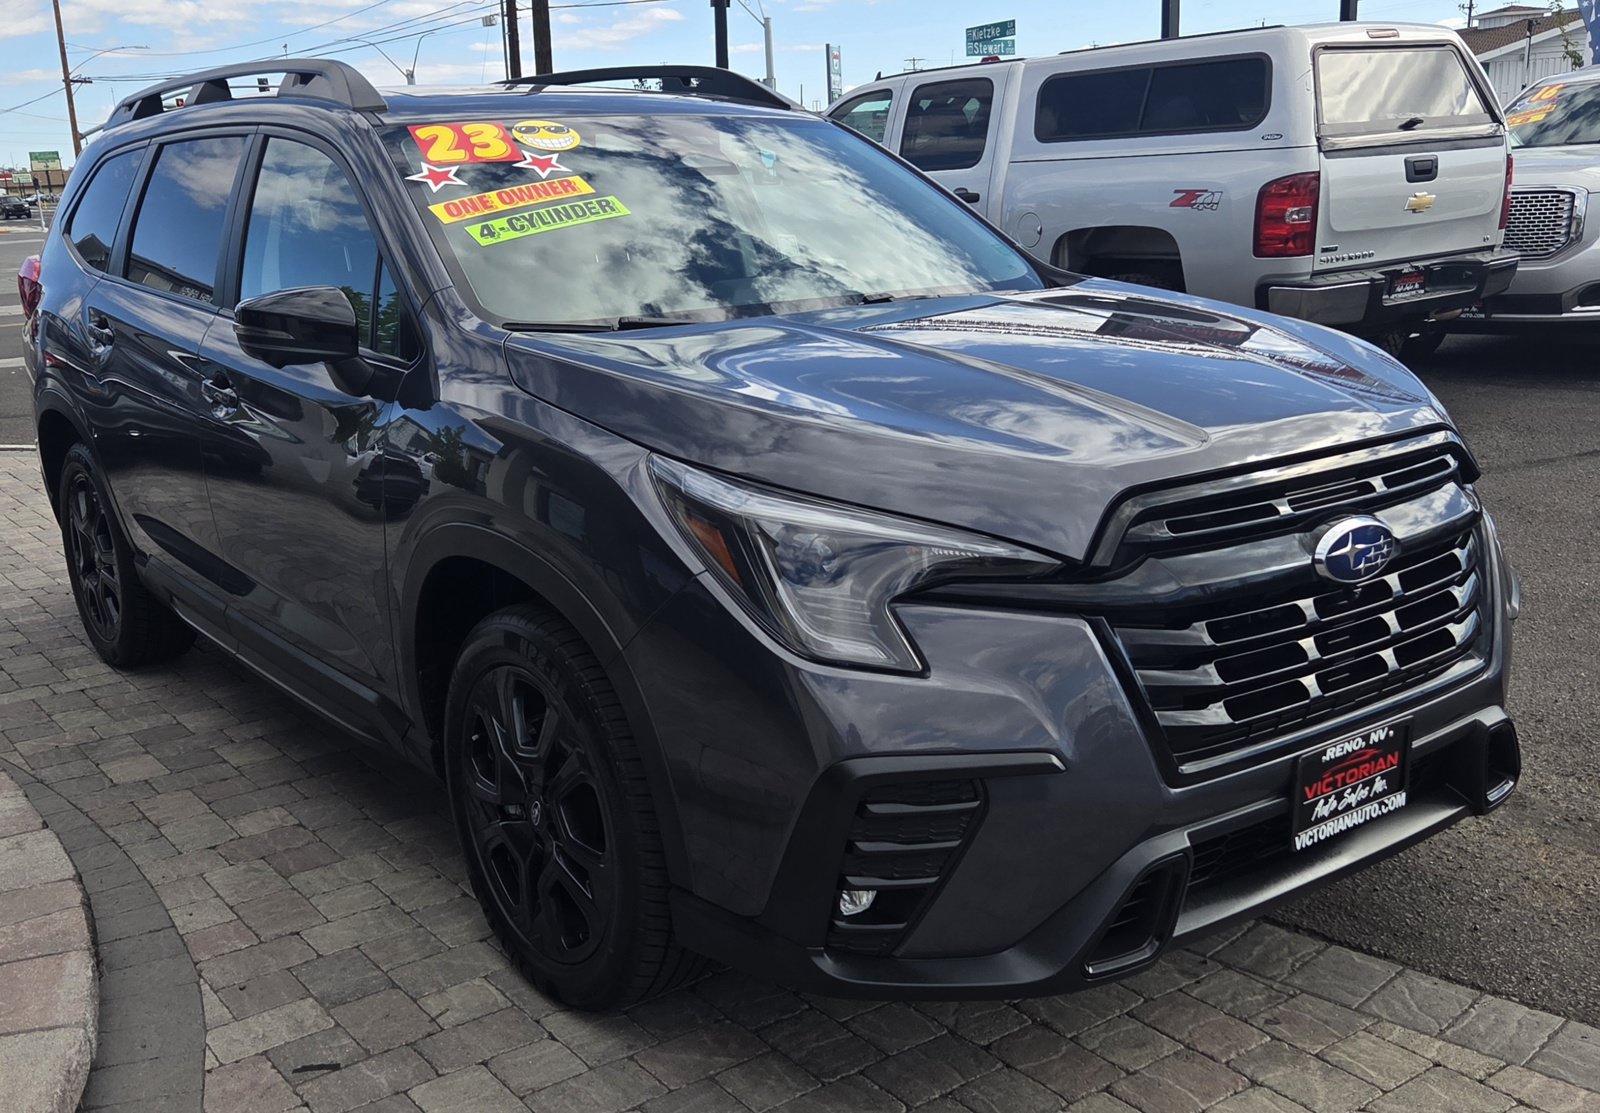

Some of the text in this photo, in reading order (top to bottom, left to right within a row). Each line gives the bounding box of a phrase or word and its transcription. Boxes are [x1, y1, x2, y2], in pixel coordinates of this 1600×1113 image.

[972, 26, 1000, 40] Kietzke
[973, 42, 1004, 54] Stewart
[415, 123, 509, 162] 23
[444, 179, 580, 219] ONE OWNER
[479, 198, 619, 241] 4-CYLINDER
[1319, 250, 1375, 265] SILVERADO
[1325, 737, 1366, 761] RENO,
[1304, 752, 1399, 799] VICTORIAN
[1295, 792, 1407, 851] VICTORIANAUTO.COM
[1312, 794, 1337, 821] Auto
[1338, 784, 1370, 811] Sales
